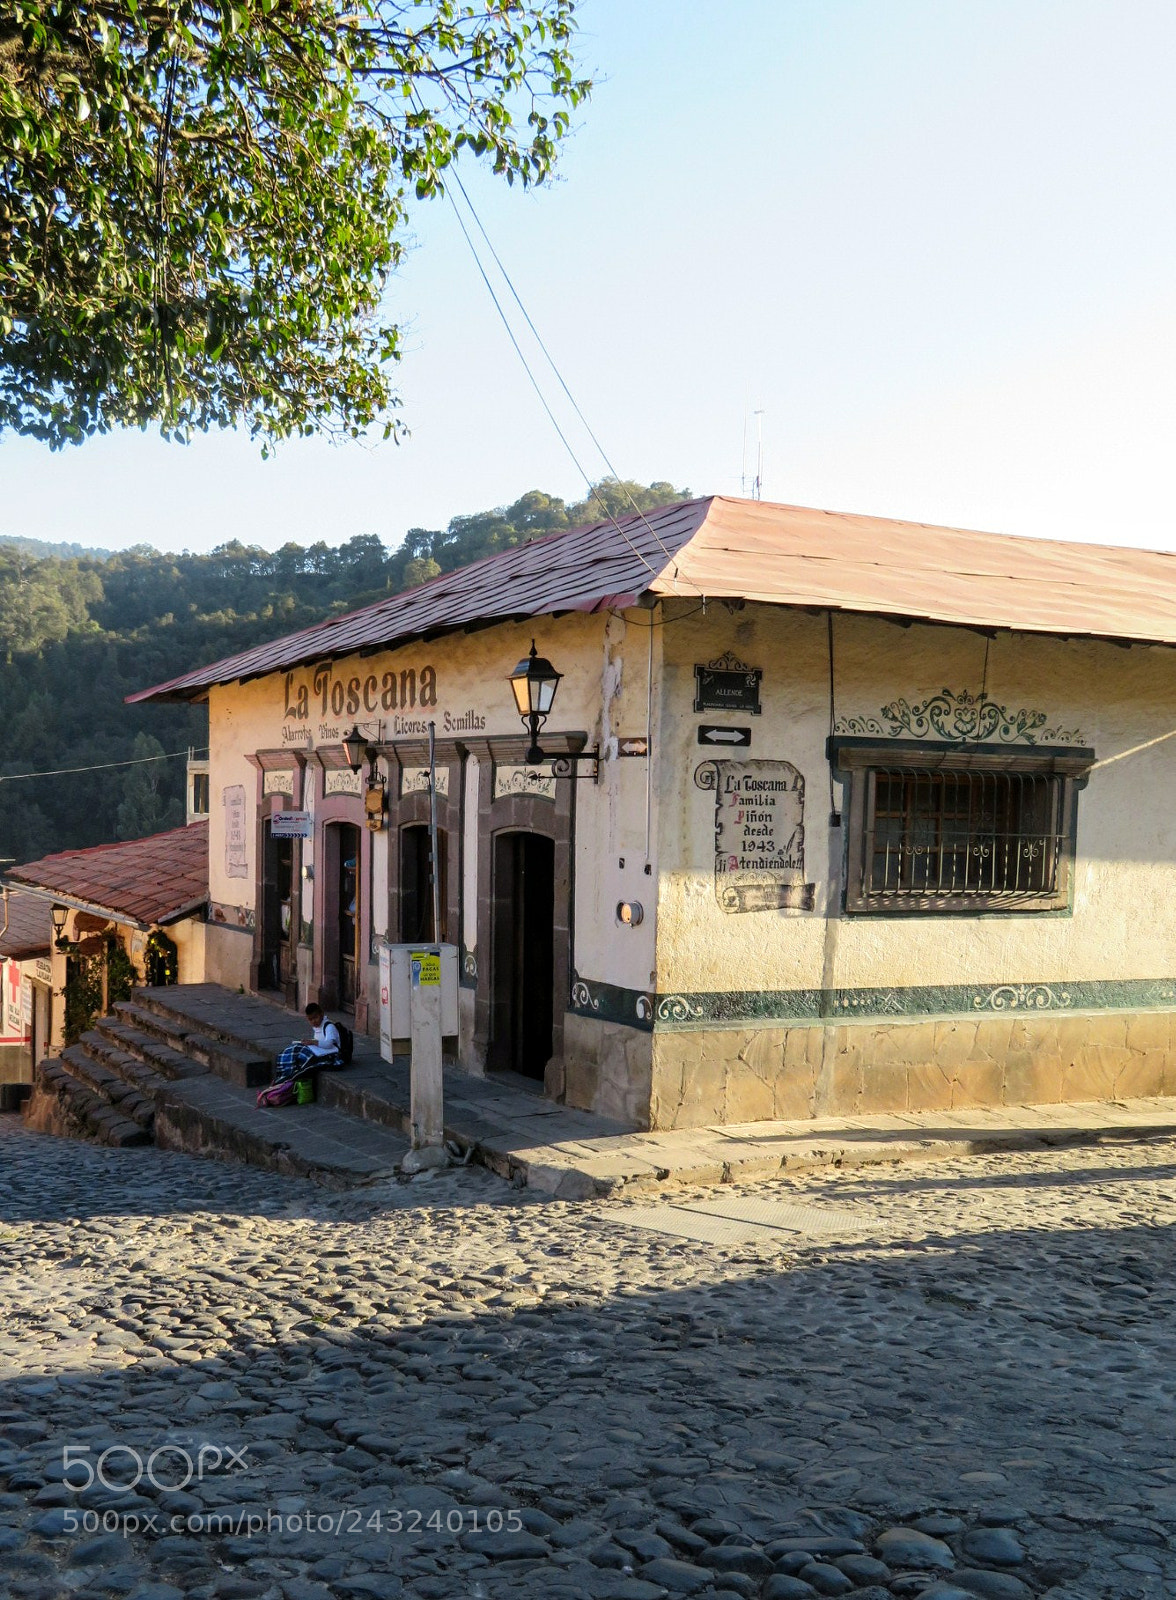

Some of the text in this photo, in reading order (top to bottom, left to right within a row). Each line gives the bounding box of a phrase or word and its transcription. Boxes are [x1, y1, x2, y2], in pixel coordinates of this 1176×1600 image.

[283, 661, 438, 720] La Toscana
[715, 688, 743, 697] ALLENDE
[318, 722, 340, 740] Vinos
[442, 709, 486, 732] Semillas
[724, 774, 788, 794] La Toscana
[729, 792, 776, 807] Familia
[743, 823, 774, 836] desde
[741, 840, 776, 853] 1943
